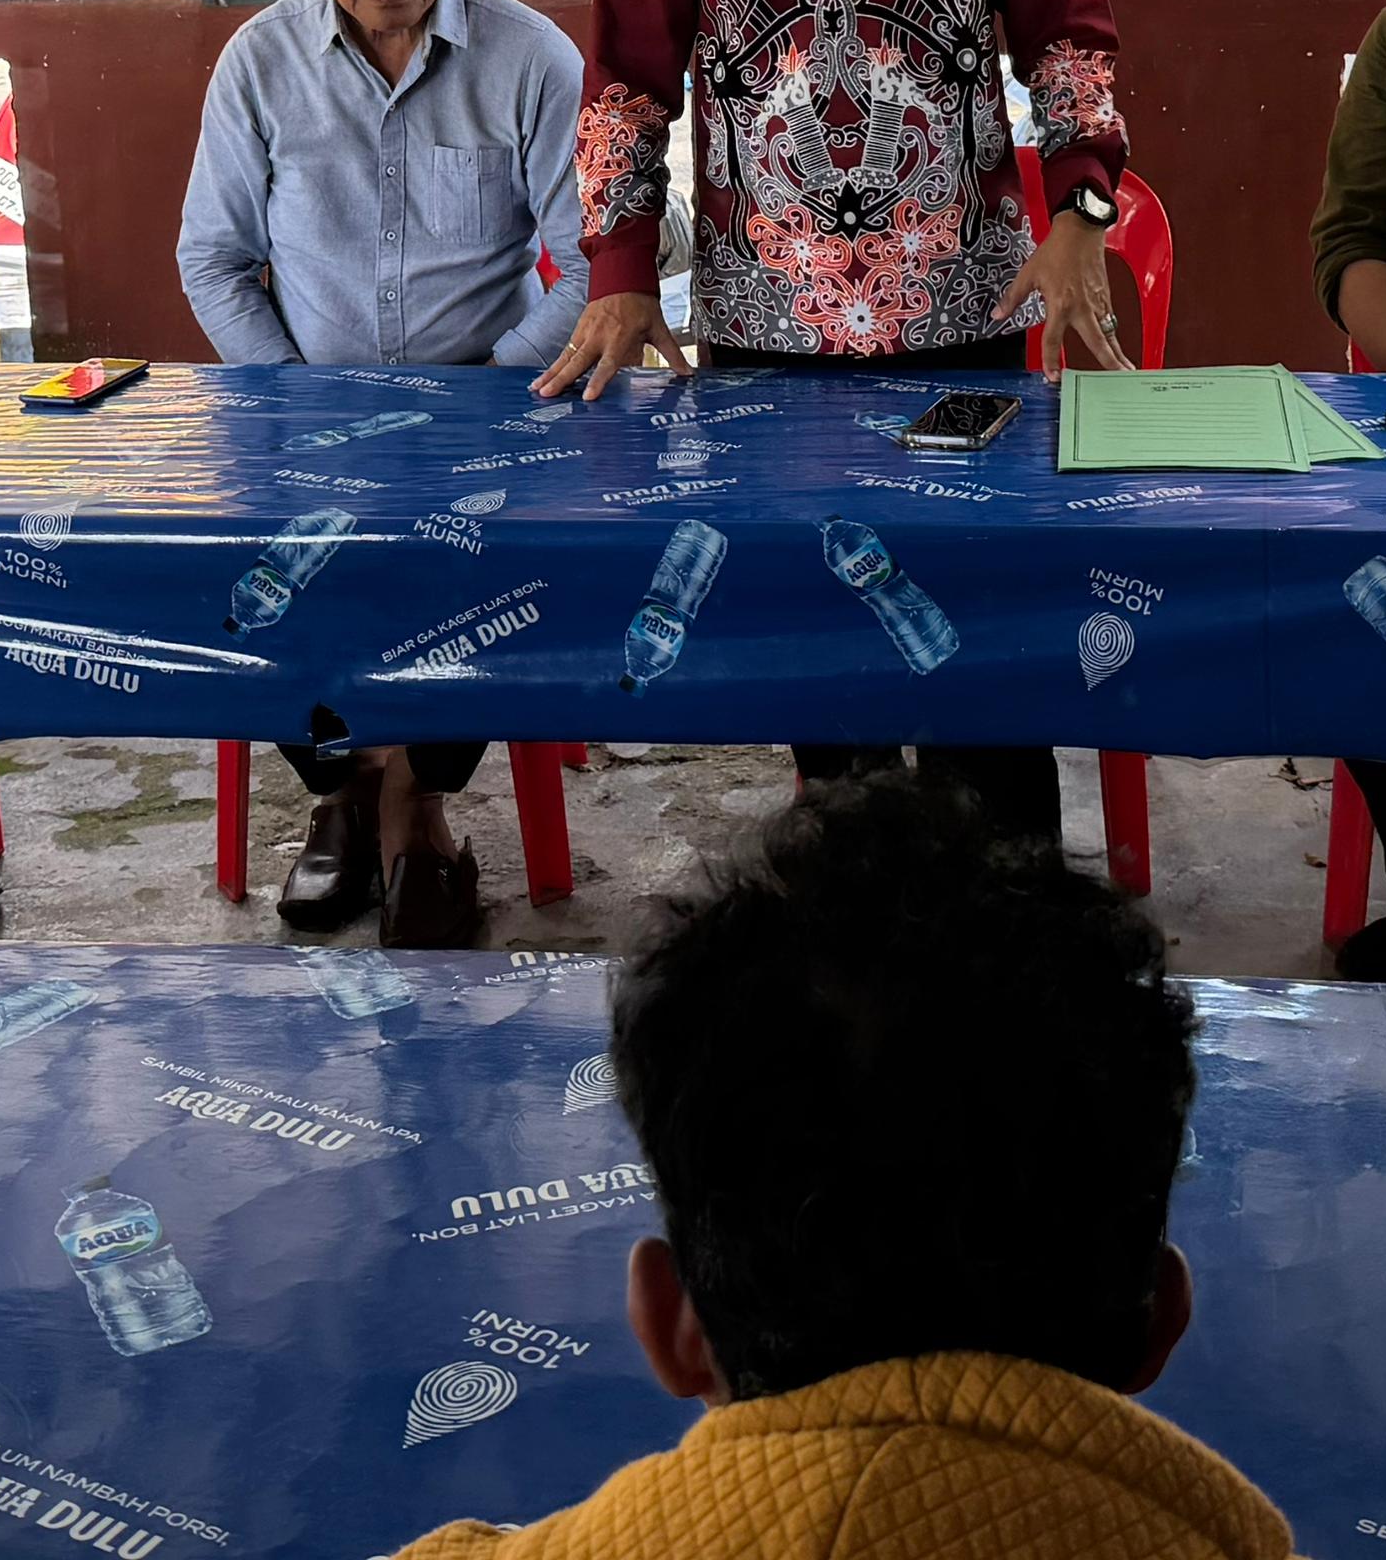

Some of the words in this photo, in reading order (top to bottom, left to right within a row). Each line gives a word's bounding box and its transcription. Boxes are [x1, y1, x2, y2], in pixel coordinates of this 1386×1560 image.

[451, 458, 515, 475] AQUA
[518, 448, 583, 465] DULU
[602, 485, 669, 503] DULU
[924, 483, 994, 502] DULU
[1067, 492, 1135, 511] DULU
[414, 519, 482, 555] MURNI
[429, 513, 483, 537] 100%
[4, 548, 63, 578] 100%
[846, 546, 887, 589] AQUA
[1089, 567, 1164, 602] MURNI
[1090, 580, 1153, 617] 100%
[382, 639, 416, 663] BIAR
[417, 629, 438, 644] GA
[437, 606, 483, 635] KAGET
[414, 634, 477, 673] AQUA
[476, 602, 540, 647] DULU
[641, 613, 682, 644] AQUA
[4, 640, 66, 676] AQUA
[74, 658, 140, 694] DULU
[484, 964, 567, 985] PESEN
[139, 1053, 209, 1088] SAMBIL
[207, 1073, 265, 1100] MIKIR
[263, 1086, 310, 1113] MAU
[307, 1097, 382, 1132] MAKAN
[154, 1082, 252, 1127] AQUA
[249, 1108, 357, 1154] DULU
[451, 1177, 572, 1219] DULU
[552, 1193, 639, 1223] KAGET
[483, 1207, 545, 1231] LIAT
[75, 1219, 156, 1257] AQUA
[465, 1327, 562, 1371] 100%
[469, 1308, 591, 1359] MURNI
[37, 1459, 146, 1518] NAMBAH
[36, 1495, 166, 1560] DULU
